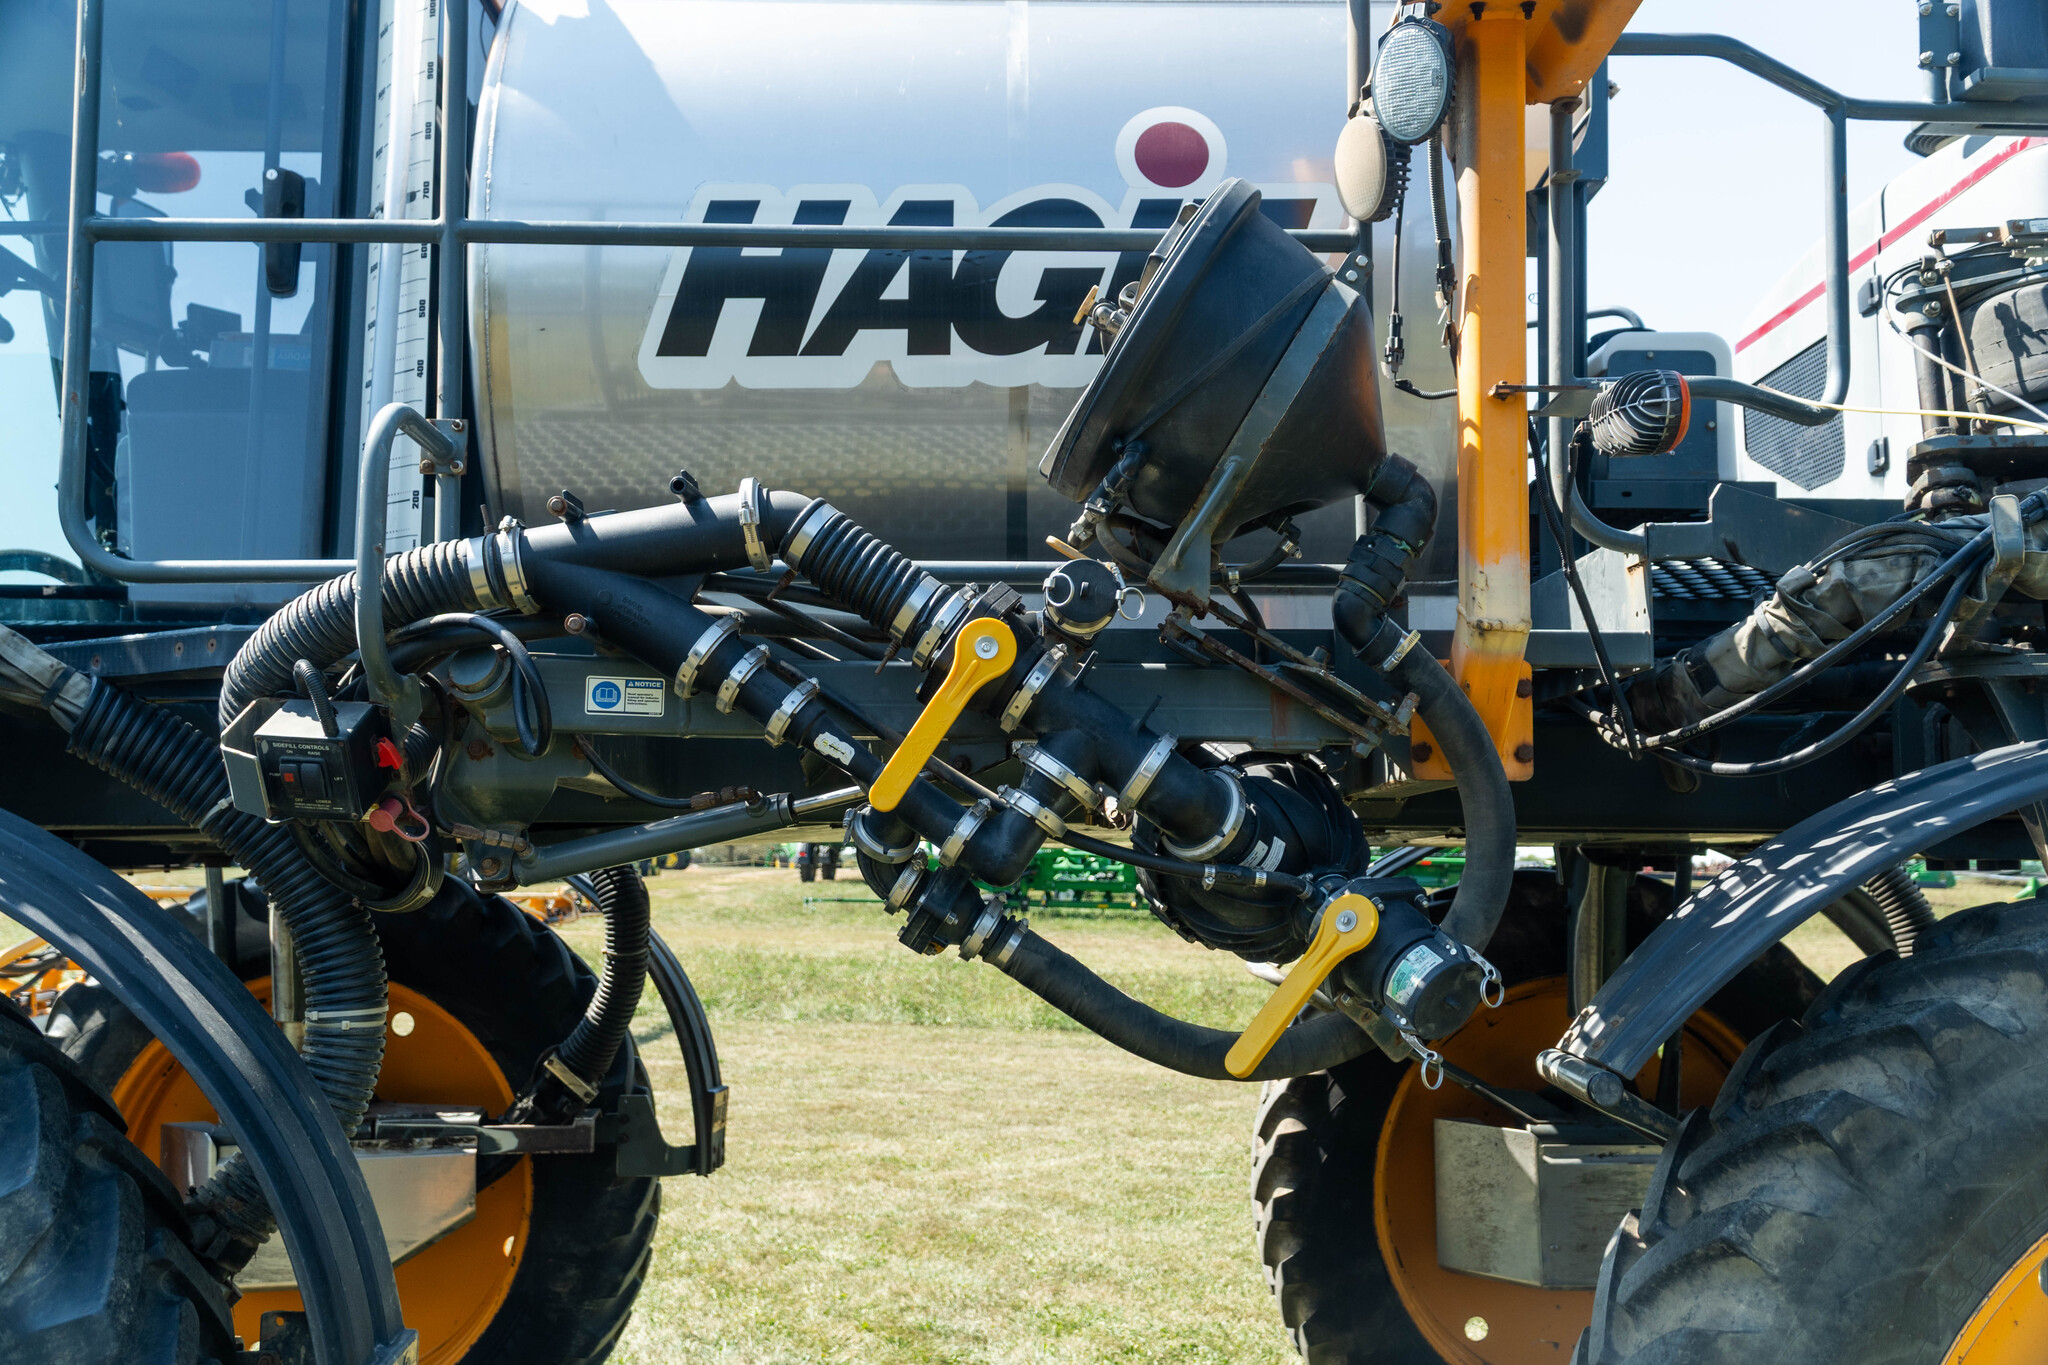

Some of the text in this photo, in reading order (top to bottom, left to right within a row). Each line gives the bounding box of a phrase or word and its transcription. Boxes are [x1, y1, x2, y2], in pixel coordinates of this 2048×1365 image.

[424, 122, 432, 140] 800
[422, 181, 430, 199] 700
[416, 360, 424, 378] 400
[412, 490, 420, 509] 200
[298, 743, 330, 751] CONTROLS
